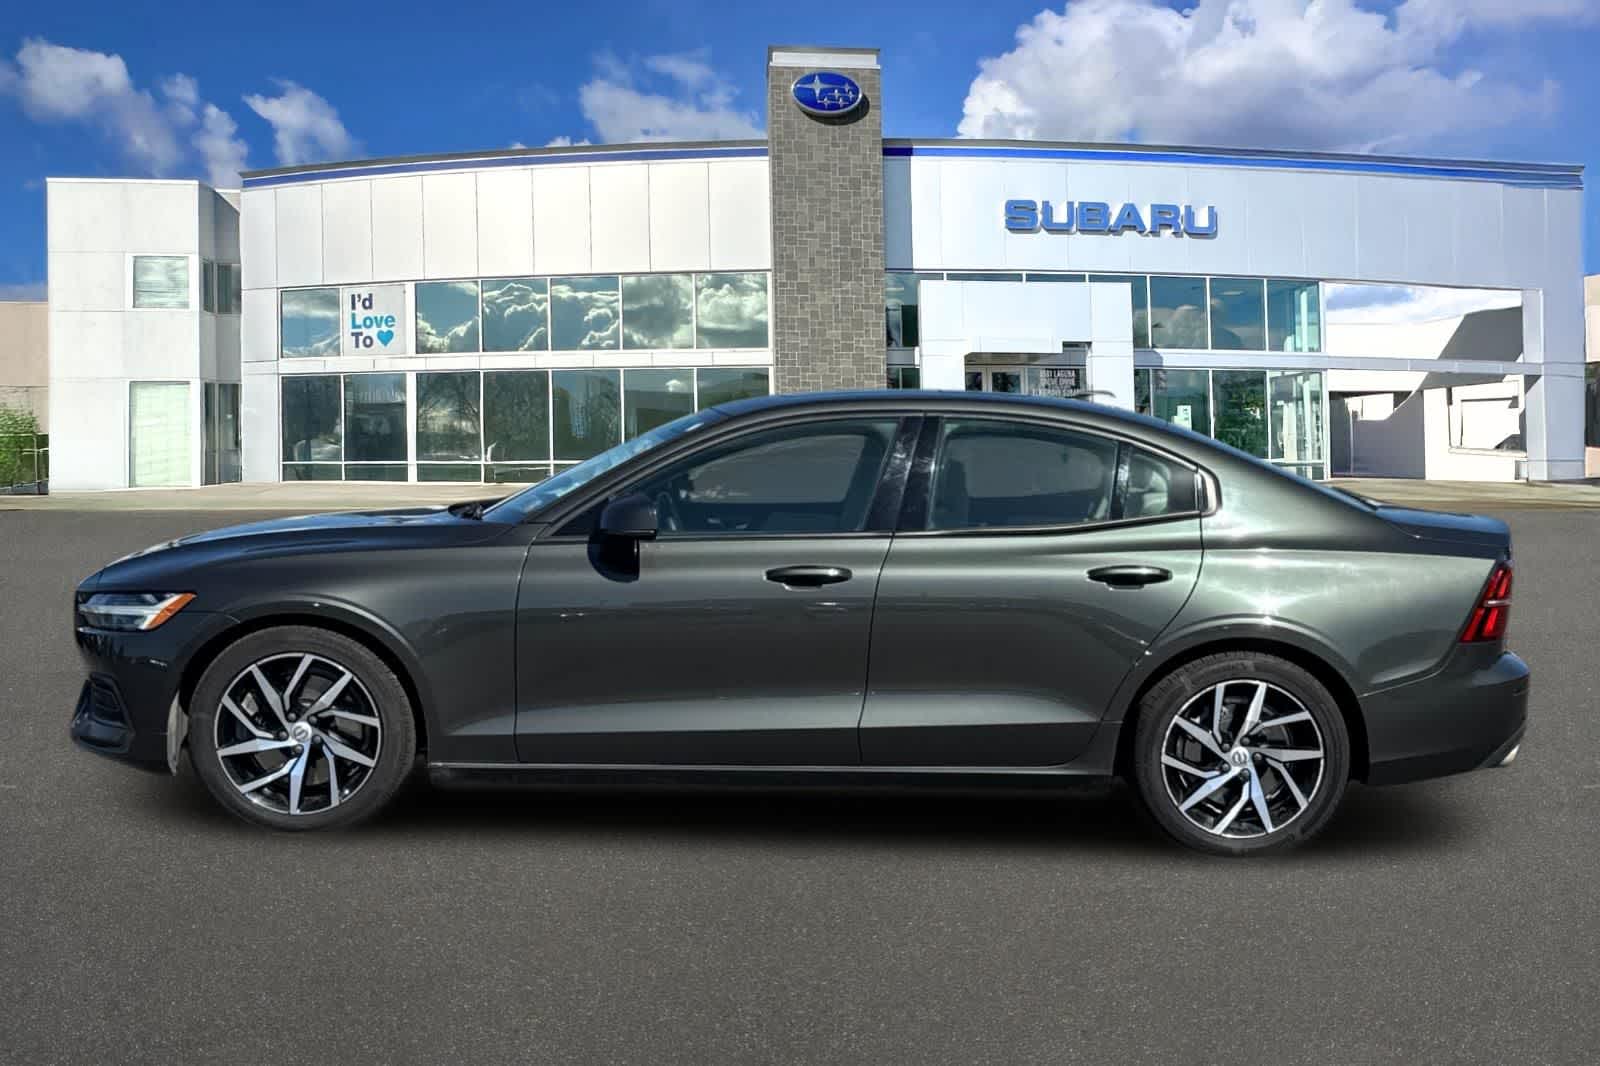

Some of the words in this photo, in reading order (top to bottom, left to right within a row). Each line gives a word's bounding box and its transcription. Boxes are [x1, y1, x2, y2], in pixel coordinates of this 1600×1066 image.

[1005, 199, 1217, 236] SUBARU
[351, 293, 373, 310] I'd
[351, 312, 396, 329] Love
[351, 332, 374, 349] To
